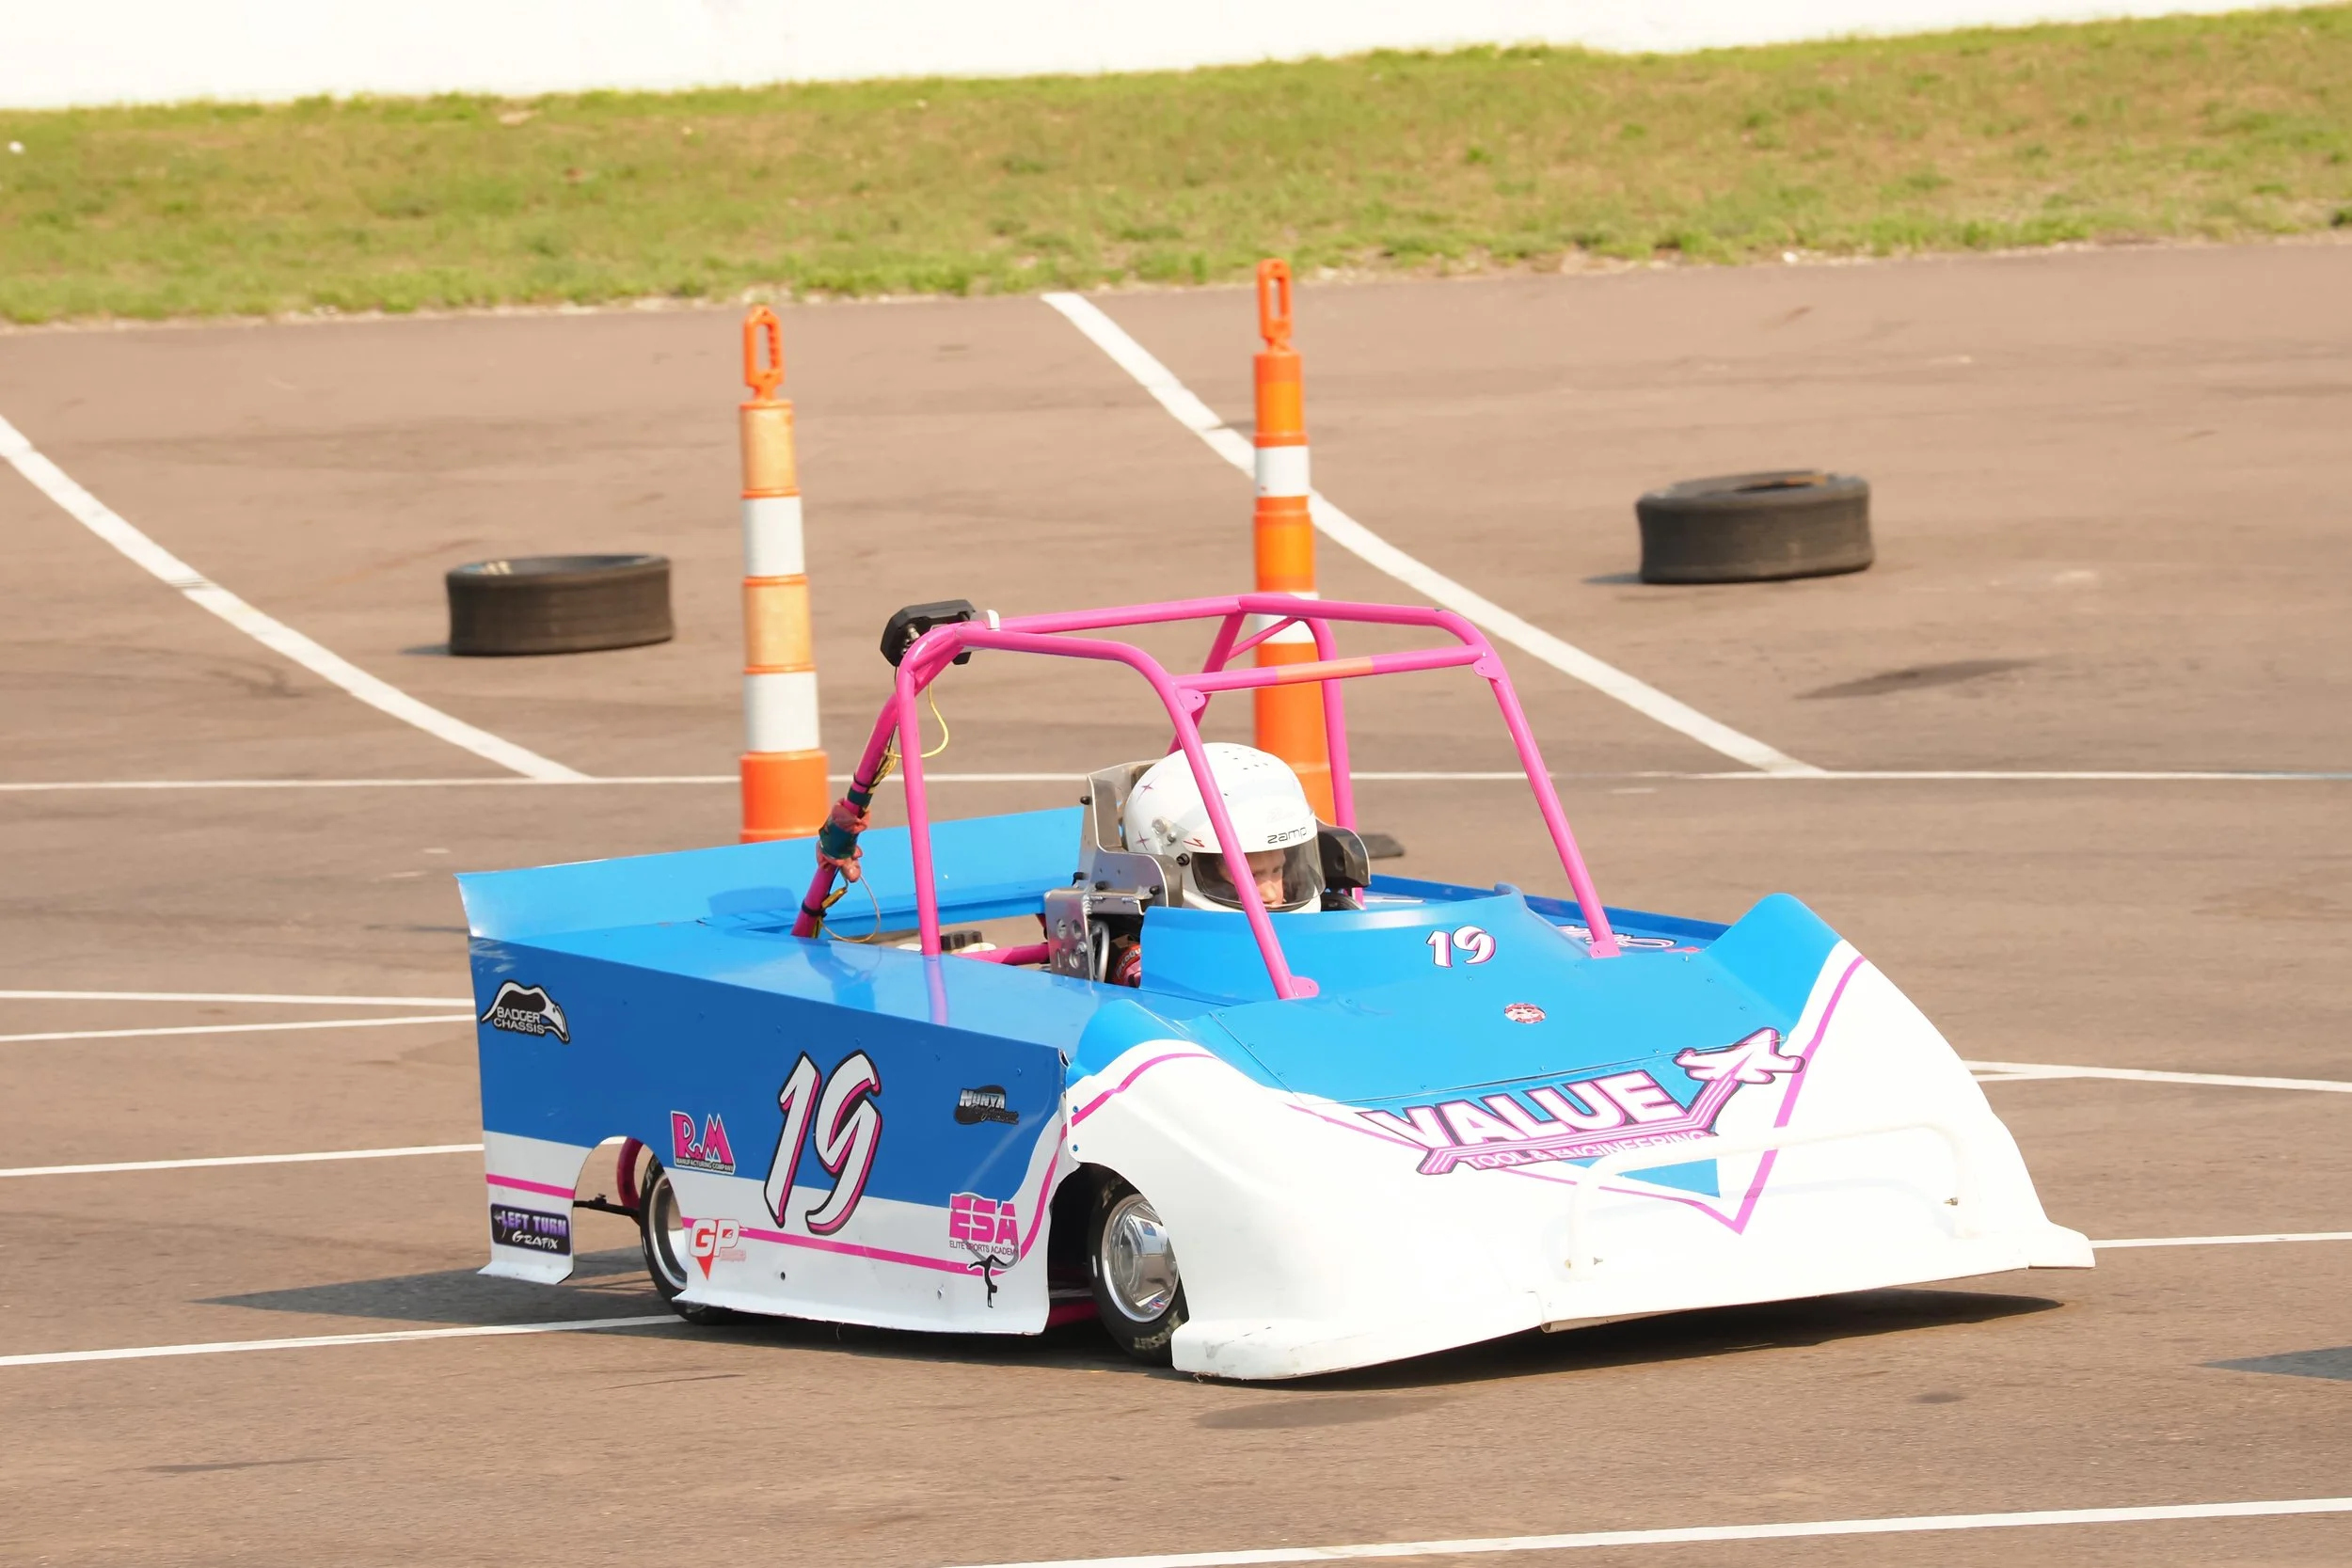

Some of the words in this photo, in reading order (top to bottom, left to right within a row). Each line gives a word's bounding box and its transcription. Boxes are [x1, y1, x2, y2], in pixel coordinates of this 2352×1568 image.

[1267, 827, 1306, 844] zamp
[1426, 926, 1496, 968] 19
[494, 1018, 546, 1034] CHASSIS
[497, 1006, 541, 1023] BADGER
[1359, 1069, 1677, 1149] VALUE
[764, 1049, 882, 1236] 19
[1465, 1150, 1531, 1168] TOOL
[1528, 1148, 1548, 1161] &
[501, 1211, 529, 1230] LEFT
[532, 1216, 566, 1236] TURN
[949, 1196, 1019, 1244] ESA
[690, 1218, 739, 1257] GP
[949, 1241, 965, 1249] ELITE
